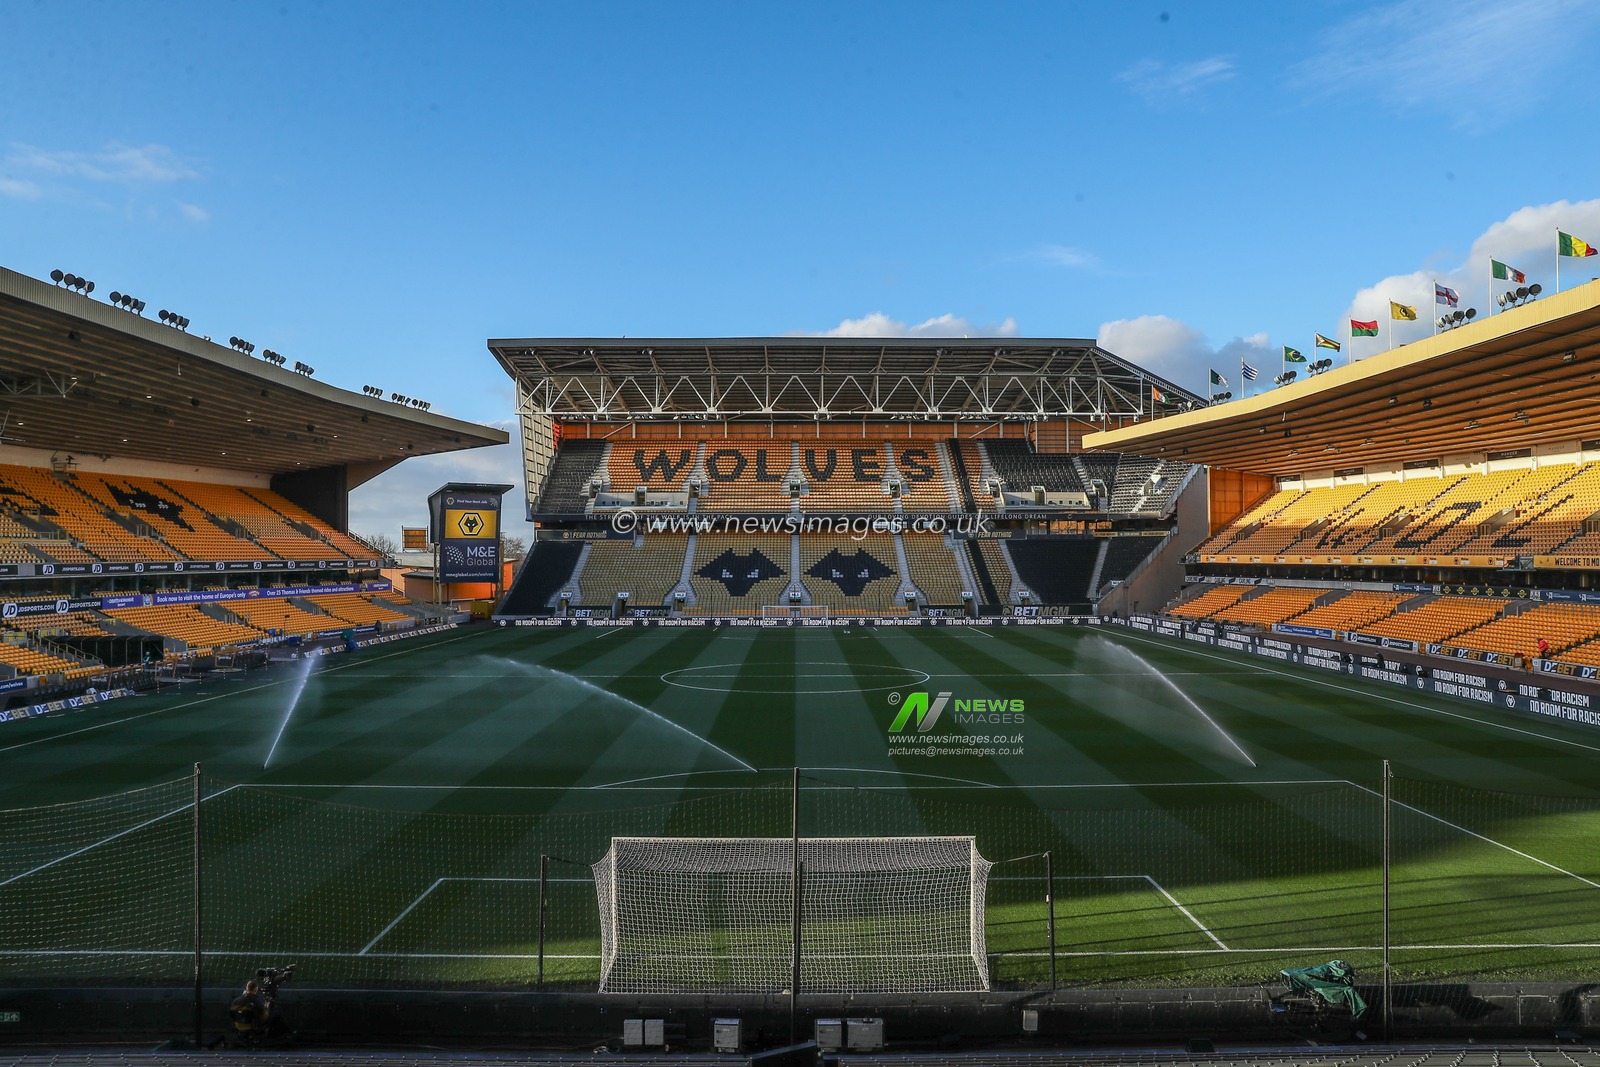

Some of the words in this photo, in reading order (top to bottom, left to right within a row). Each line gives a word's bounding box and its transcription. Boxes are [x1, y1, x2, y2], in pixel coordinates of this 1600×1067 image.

[632, 449, 935, 482] WOLVES
[467, 547, 495, 557] M&E
[467, 558, 495, 566] Global
[1555, 558, 1581, 566] WELCOME
[4, 604, 16, 616] JD
[57, 601, 68, 612] JD
[1014, 606, 1069, 616] BETMGM
[1544, 661, 1577, 675] DEBET
[1362, 667, 1367, 676] NO
[1368, 668, 1380, 680] ROOM
[1380, 671, 1389, 681] FOR
[1389, 672, 1408, 685] RACISM
[1433, 669, 1440, 679] NO
[1440, 670, 1454, 682] ROOM
[1455, 673, 1464, 683] FOR
[1466, 675, 1486, 687] RACISM
[1435, 681, 1442, 692] NO
[1443, 683, 1458, 696] ROOM
[1458, 686, 1470, 698] FOR
[1470, 688, 1493, 703] RACISM
[1520, 685, 1528, 696] NO
[1562, 691, 1589, 707] RACISM
[34, 700, 66, 714] DEBET
[69, 695, 98, 707] DEBET
[1530, 700, 1540, 712] NO
[1541, 702, 1561, 718] ROOM
[1562, 705, 1577, 721] FOR
